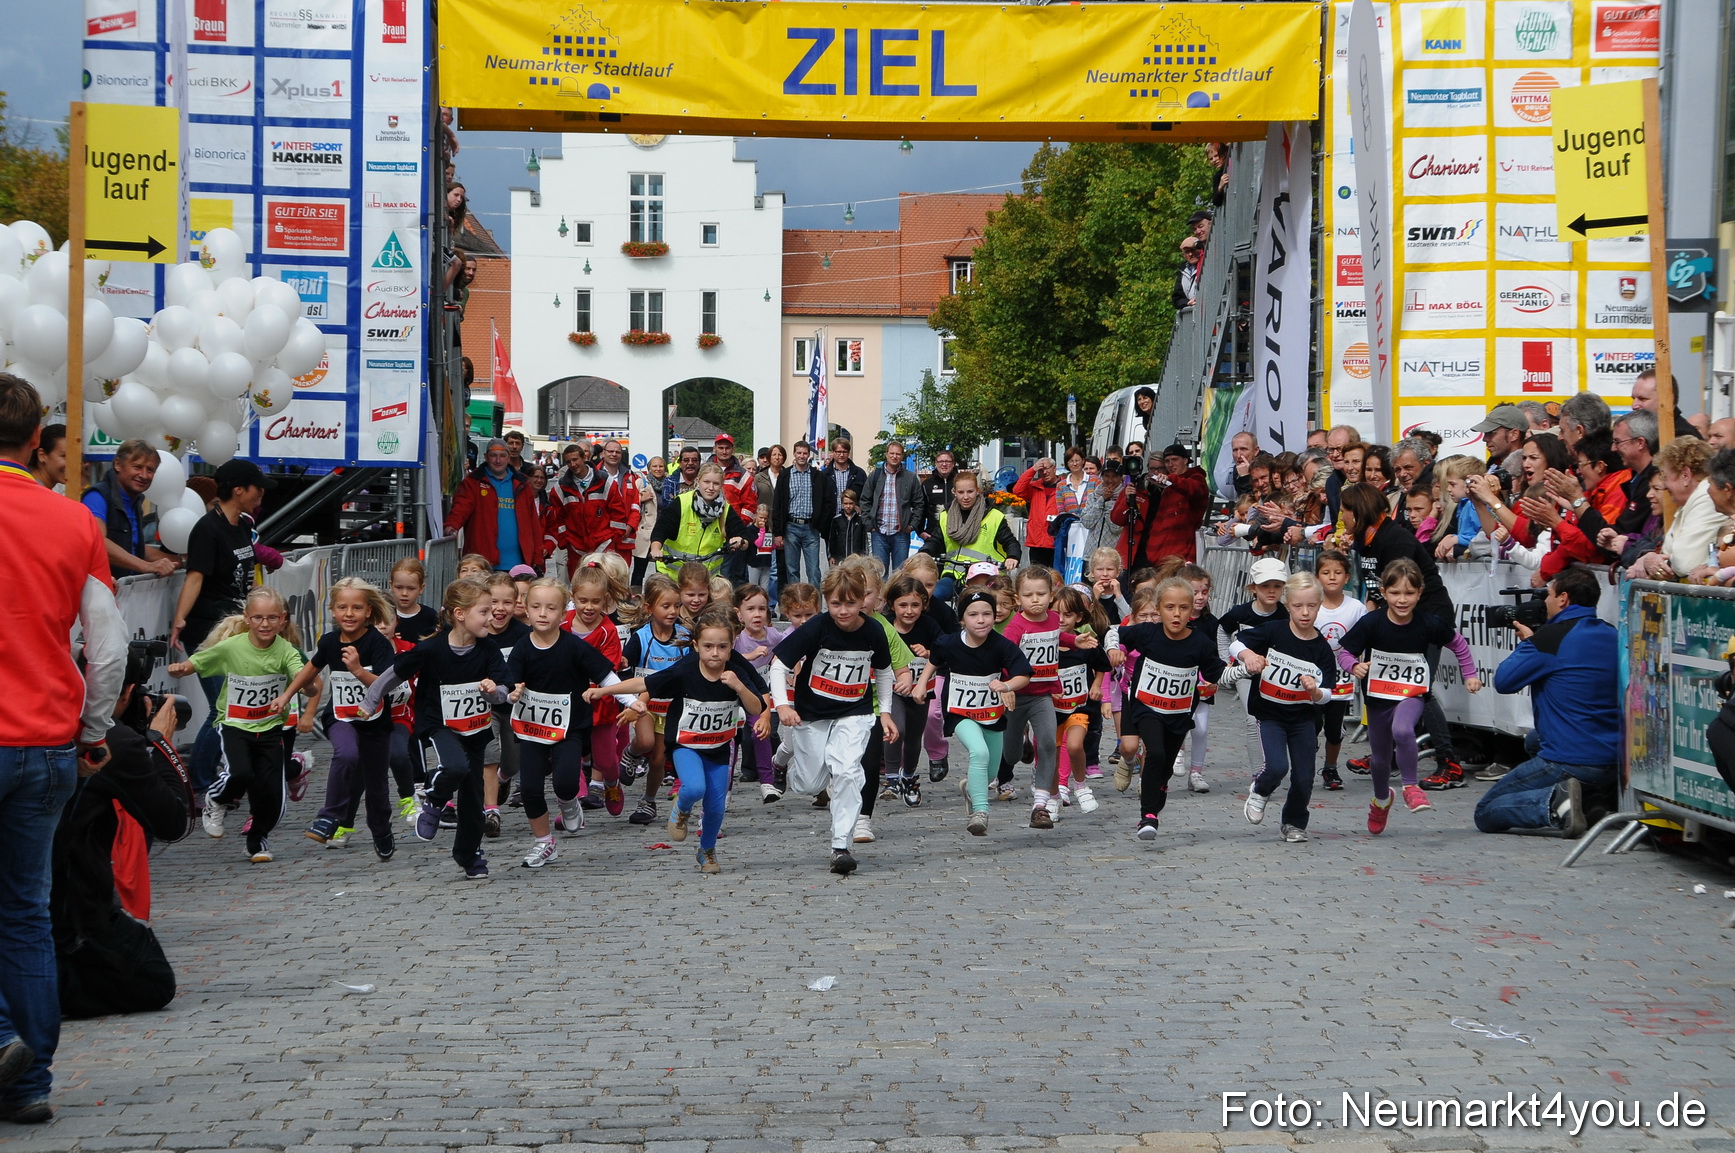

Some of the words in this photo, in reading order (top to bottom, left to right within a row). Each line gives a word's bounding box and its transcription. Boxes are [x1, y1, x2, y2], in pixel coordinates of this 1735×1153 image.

[1603, 10, 1626, 20] GUT
[1626, 9, 1646, 19] FÜR
[193, 17, 225, 32] Braun
[383, 23, 406, 35] Braun
[1425, 39, 1462, 50] KANN
[484, 54, 588, 75] Neumarkter
[593, 61, 674, 79] Stadtlauf
[782, 27, 978, 97] ZIEL
[96, 74, 149, 88] Bionorica
[187, 77, 209, 87] udi
[210, 77, 238, 88] BKK
[1085, 68, 1188, 86] Neumarkter
[1192, 66, 1274, 85] Stadtlauf
[1410, 92, 1449, 100] Neumarkter
[1449, 91, 1479, 102] Tagblatt
[1510, 95, 1552, 103] WITTMA
[282, 141, 343, 151] INTERSPORT
[194, 148, 247, 161] Bionorica
[272, 152, 343, 164] HACKNER
[368, 163, 396, 171] Neumarkter
[1408, 154, 1483, 179] Charivari
[1586, 153, 1631, 179] lauf
[104, 176, 150, 200] lauf
[274, 206, 296, 217] GUT
[296, 206, 318, 218] FÜR
[318, 208, 338, 218] SIE!
[284, 227, 312, 235] Sparkasse
[1407, 226, 1457, 241] swn
[287, 276, 324, 296] maxi
[307, 304, 323, 316] dsl
[364, 301, 419, 319] Charivari
[1429, 302, 1452, 310] MAX
[1456, 300, 1483, 309] BÖGL
[1519, 299, 1549, 307] JANIG
[1605, 304, 1648, 313] Neumarkter
[367, 329, 399, 338] swn
[1404, 360, 1480, 377] NATHUS
[1522, 369, 1552, 383] Braun
[264, 416, 342, 440] Charivari
[1443, 429, 1470, 438] BKK
[1144, 662, 1162, 675] PARTL
[1162, 669, 1190, 678] Neumarkt
[1268, 652, 1284, 664] PARTL
[1286, 660, 1314, 675] Neumarkt
[820, 660, 865, 683] 7171
[1268, 662, 1316, 689] 704
[1377, 663, 1425, 685] 7348
[820, 680, 859, 696] Franziska
[951, 678, 968, 686] PARTL
[1147, 672, 1191, 696] 7050
[235, 684, 279, 707] 7235
[442, 688, 465, 697] PARTL
[955, 688, 999, 707] 7279
[1275, 689, 1297, 700] Anne
[449, 696, 491, 718] 725
[530, 696, 560, 705] Neumarkt
[1150, 697, 1167, 707] Jule
[517, 700, 563, 727] 7176
[688, 710, 734, 731] 7054
[965, 709, 990, 720] Sarah
[467, 717, 487, 729] Jule
[523, 723, 552, 738] Sophie
